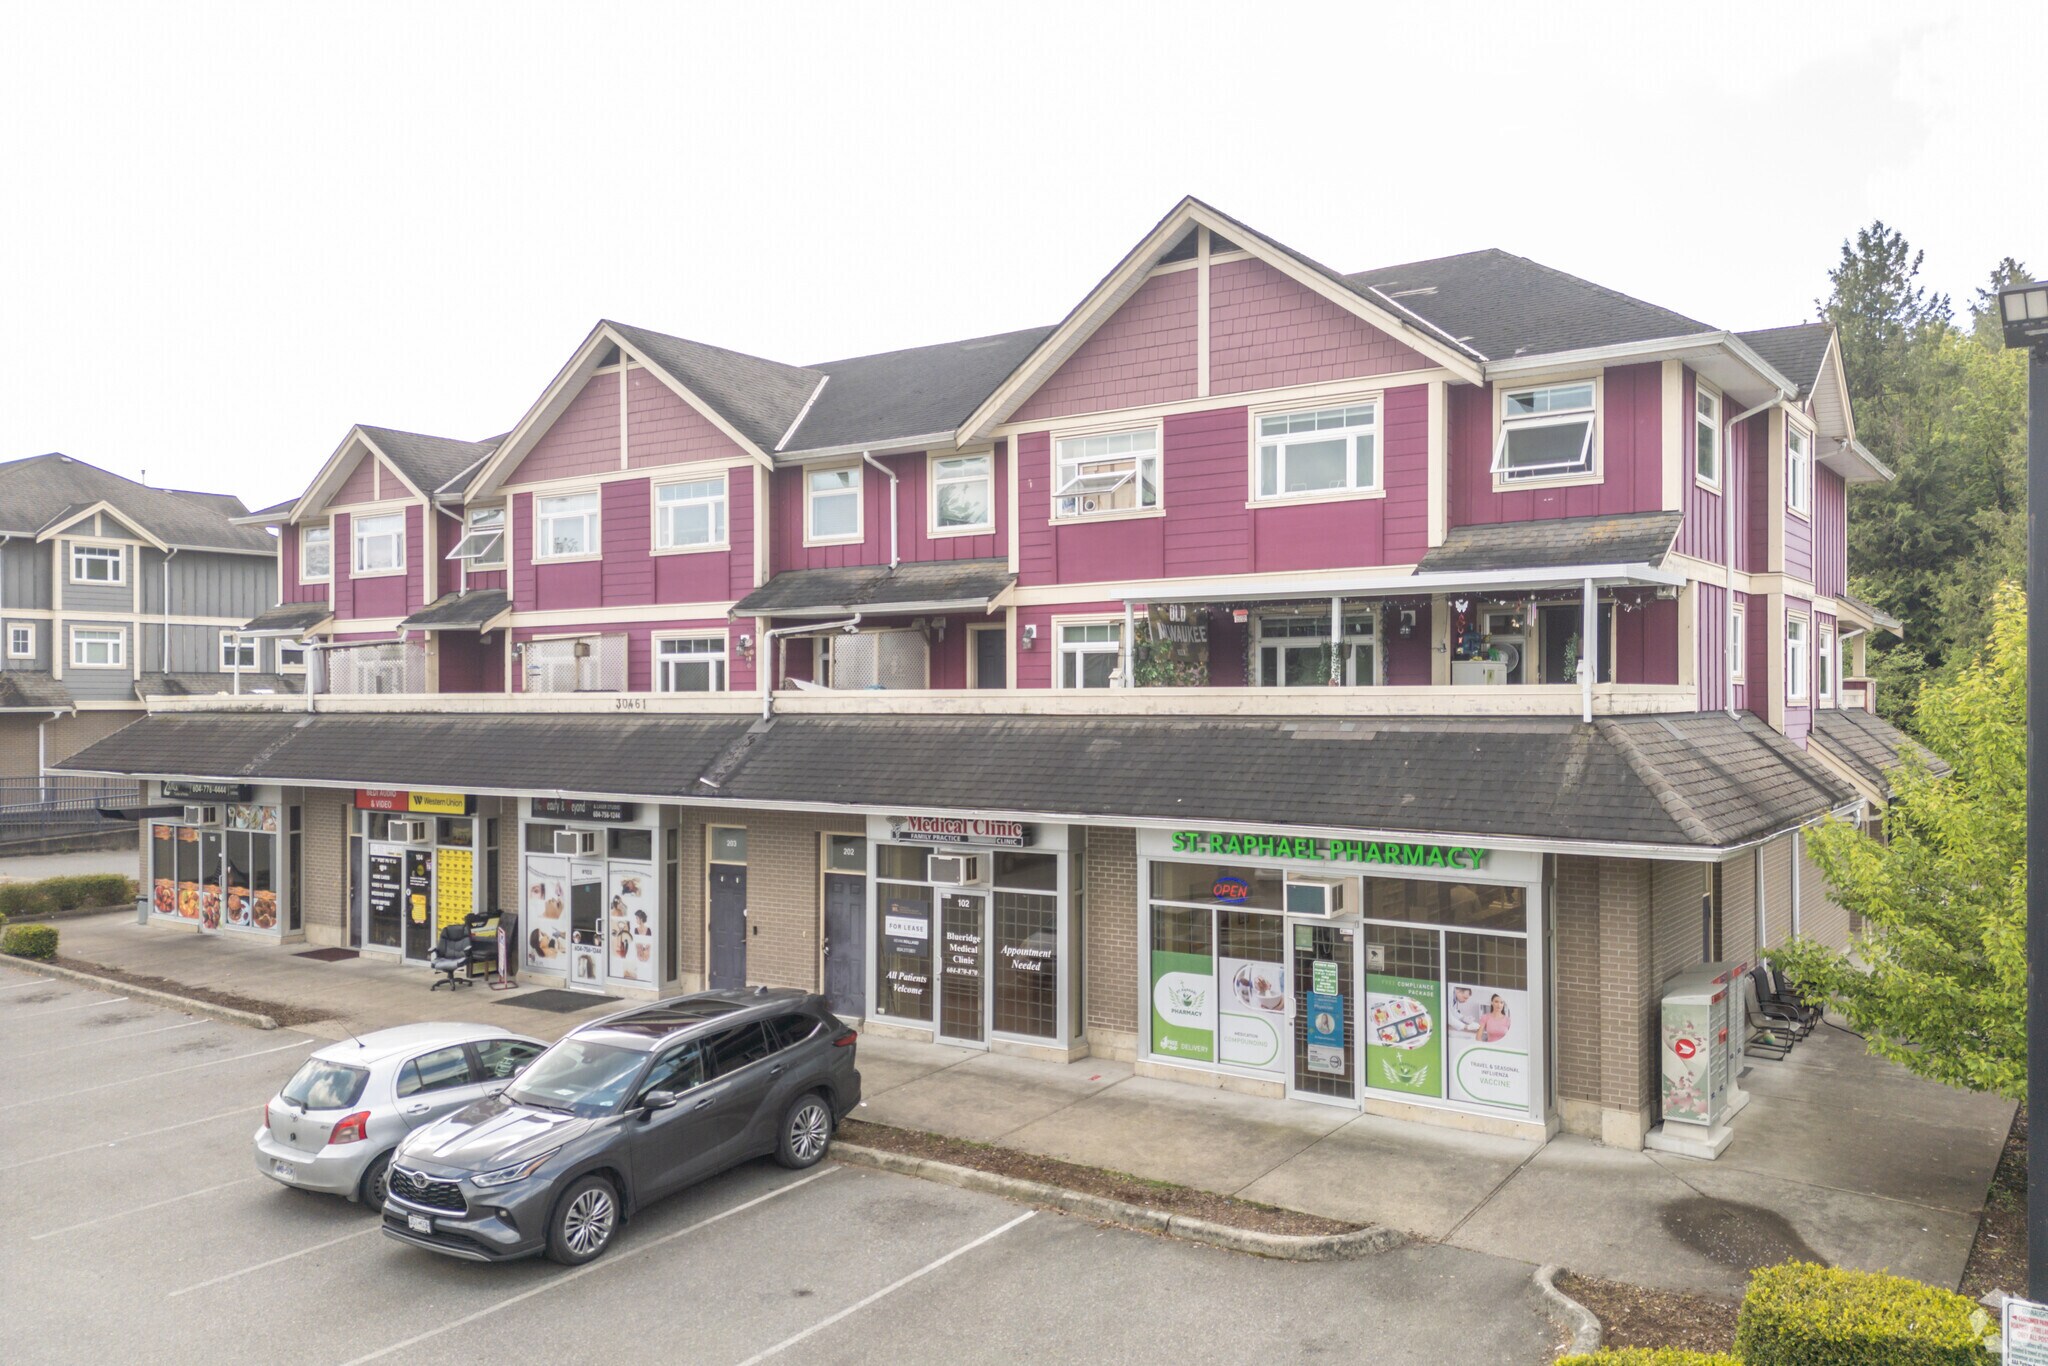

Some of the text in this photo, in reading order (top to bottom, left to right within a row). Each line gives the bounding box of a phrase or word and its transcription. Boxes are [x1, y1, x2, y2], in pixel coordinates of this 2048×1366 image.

[1169, 604, 1186, 622] OLD
[1157, 622, 1207, 643] MWAUKEE
[616, 698, 646, 710] 30461
[370, 799, 392, 808] & VIDEO
[424, 797, 446, 805] Western
[446, 798, 463, 807] Union
[906, 816, 1023, 837] Medical Clinic
[933, 834, 961, 842] PRACTICE
[843, 847, 855, 856] 202
[1171, 831, 1485, 870] ST. RAPHAEL PHARMACY
[1213, 883, 1248, 898] OPEN
[957, 899, 970, 908] 102
[903, 925, 924, 933] LEASE
[946, 932, 981, 945] Blueridge
[949, 944, 978, 954] Medical
[1000, 944, 1052, 958] Appointment
[952, 955, 975, 965] Clinic
[1011, 959, 1042, 971] Needed
[885, 971, 927, 983] All Patients
[1397, 981, 1435, 991] COMPLIANCE
[1408, 990, 1435, 998] PACKAGE
[1171, 1008, 1203, 1017] PHARMACY
[1224, 1036, 1269, 1048] COMPOUNDING
[1180, 1043, 1209, 1053] DELIVERY
[1470, 1061, 1488, 1069] TRAVEL
[1494, 1065, 1520, 1073] SEASONAL
[1481, 1070, 1509, 1078] INFLUENZA
[1479, 1078, 1511, 1088] VACCINE
